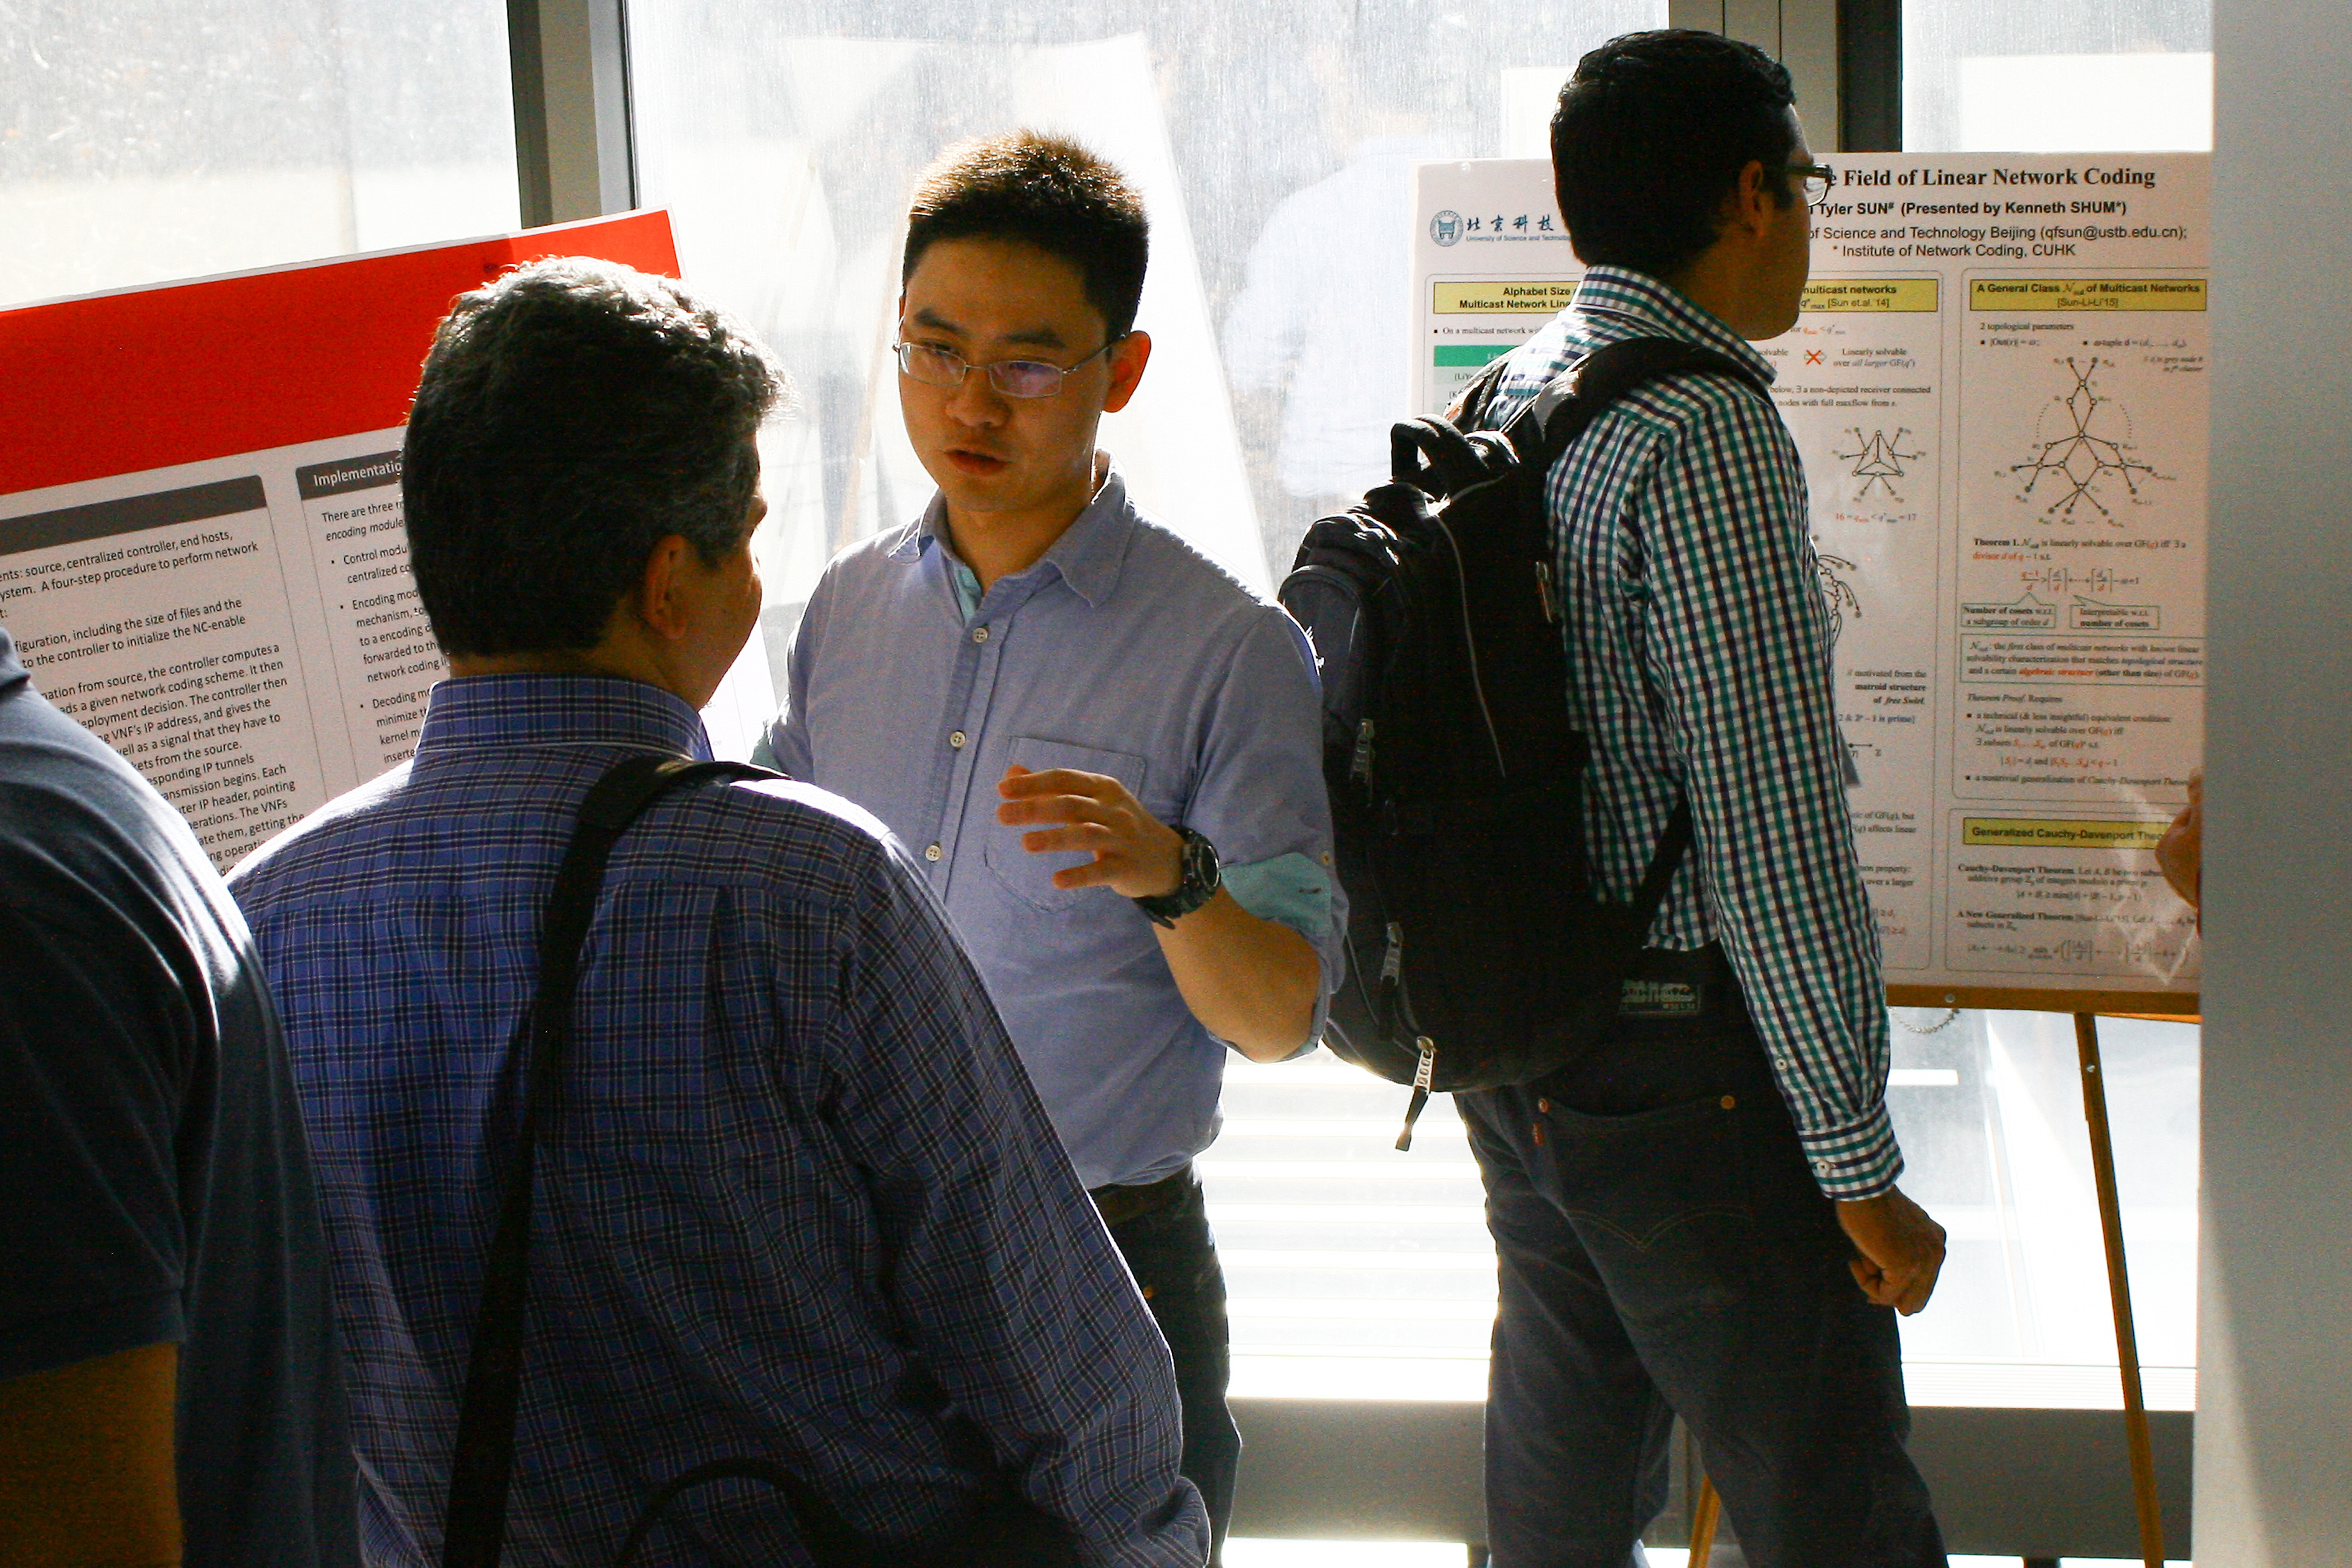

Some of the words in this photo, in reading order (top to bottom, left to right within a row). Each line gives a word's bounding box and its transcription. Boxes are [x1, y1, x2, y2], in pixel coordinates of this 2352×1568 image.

[1844, 169, 1891, 186] Field
[1898, 169, 1917, 186] of
[1922, 169, 1988, 186] Linear
[1993, 168, 2078, 185] Network
[2084, 168, 2156, 189] Coding
[1820, 203, 1852, 218] Tyler
[1901, 202, 1978, 217] (Presented
[1984, 202, 2003, 217] by
[2005, 202, 2066, 214] Kenneth
[1823, 227, 1876, 240] Science
[1881, 226, 1906, 240] and
[1910, 226, 1986, 242] Technology
[1990, 226, 2036, 240] Beijing
[1843, 244, 1895, 257] Institute
[1900, 244, 1912, 257] of
[1916, 244, 1970, 257] Network
[1976, 244, 2028, 259] Coding,
[2032, 244, 2076, 256] CUHK
[1503, 287, 1547, 297] Alphabet
[1550, 287, 1571, 295] Size
[1850, 286, 1897, 294] networks
[1977, 284, 1986, 293] A
[1988, 284, 2028, 293] General
[2031, 284, 2060, 293] Class
[2086, 284, 2097, 293] of
[2100, 284, 2148, 293] Multicast
[2151, 284, 2201, 293] Networks
[1459, 300, 1504, 309] Multicast
[1506, 300, 1547, 309] Network
[321, 511, 350, 523] There
[350, 508, 367, 518] are
[367, 503, 394, 515] three
[325, 526, 367, 541] encoding
[25, 563, 66, 578] source,
[66, 548, 125, 569] centralized
[126, 540, 180, 558] controller,
[179, 534, 200, 548] end
[200, 531, 233, 545] hosts,
[343, 549, 378, 565] Control
[41, 581, 50, 592] A
[50, 573, 103, 590] four-step
[102, 563, 157, 583] procedure
[157, 560, 172, 570] to
[171, 552, 214, 569] perform
[214, 540, 259, 559] network
[347, 564, 398, 584] centralized
[352, 594, 396, 610] Encoding
[15, 634, 71, 653] figuration,
[71, 623, 123, 641] including
[123, 618, 143, 630] the
[145, 614, 165, 627] size
[166, 609, 178, 622] of
[179, 607, 201, 620] files
[203, 600, 223, 615] and
[223, 598, 243, 610] the
[356, 610, 413, 628] mechanism,
[36, 654, 56, 666] the
[56, 642, 110, 662] controller
[126, 631, 171, 648] initialize
[172, 626, 192, 638] the
[192, 615, 246, 634] NC-enable
[379, 626, 424, 642] encoding
[363, 644, 413, 665] forwarded
[76, 681, 105, 694] from
[106, 673, 147, 688] source,
[148, 667, 167, 679] the
[169, 656, 220, 675] controller
[221, 645, 273, 664] computes
[367, 665, 407, 683] network
[407, 659, 440, 674] coding
[89, 696, 119, 712] given
[119, 683, 166, 703] network
[168, 678, 204, 693] coding
[204, 669, 249, 685] scheme.
[249, 665, 258, 675] It
[259, 661, 284, 673] then
[80, 708, 140, 730] eployment
[139, 700, 188, 717] decision.
[188, 694, 211, 706] The
[211, 682, 261, 701] controller
[263, 678, 287, 690] then
[372, 691, 417, 710] Decoding
[111, 724, 142, 740] VNF's
[143, 722, 154, 734] IP
[157, 714, 201, 731] address,
[203, 706, 223, 721] and
[225, 703, 252, 718] gives
[252, 698, 272, 710] the
[376, 711, 418, 728] minimize
[160, 730, 191, 748] signal
[192, 727, 216, 740] that
[217, 722, 241, 736] they
[242, 717, 269, 730] have
[379, 729, 409, 746] kernel
[155, 754, 181, 767] from
[182, 748, 201, 760] the
[203, 741, 242, 756] source.
[202, 762, 213, 774] IP
[214, 753, 255, 771] tunnels
[222, 773, 260, 788] begins.
[261, 763, 287, 779] Each
[198, 799, 209, 811] IP
[211, 791, 250, 808] header,
[252, 780, 296, 800] pointing
[238, 806, 260, 818] The
[260, 799, 288, 813] VNFs
[215, 828, 248, 842] them,
[249, 818, 286, 837] getting
[1972, 826, 2035, 838] Generalized
